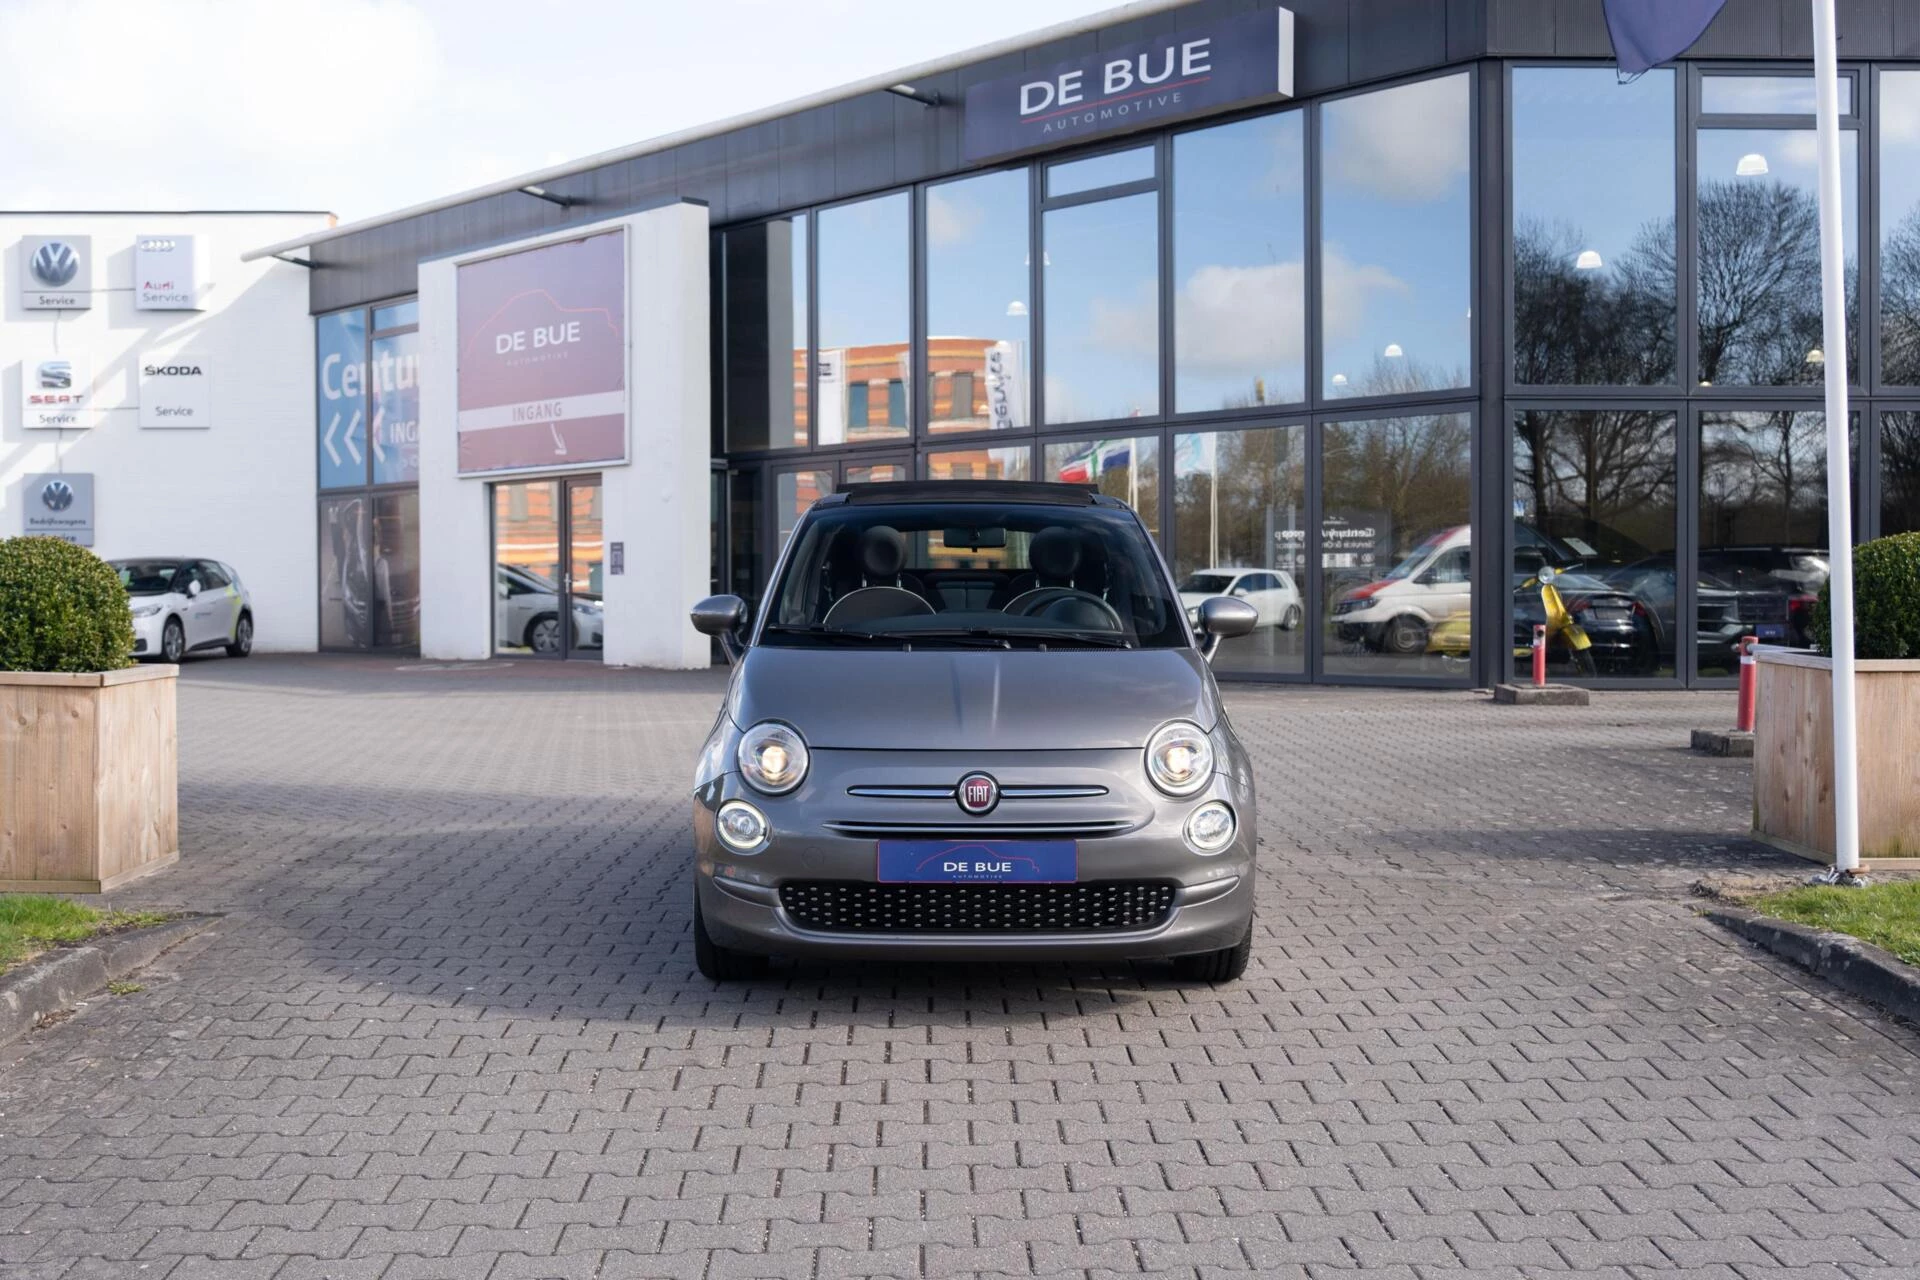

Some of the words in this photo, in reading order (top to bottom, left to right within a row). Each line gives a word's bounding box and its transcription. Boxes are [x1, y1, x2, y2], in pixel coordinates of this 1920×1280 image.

[1019, 70, 1083, 116] DE
[1103, 37, 1212, 95] BUE
[1042, 92, 1182, 134] AUTOMOTIVE
[143, 280, 175, 290] Audi
[39, 295, 76, 305] Service
[142, 292, 189, 302] Service
[496, 330, 526, 354] DE
[533, 321, 581, 348] BUE
[29, 395, 83, 404] SEAT
[155, 406, 193, 417] Service
[512, 401, 562, 422] INGANG
[39, 413, 76, 425] Service
[967, 785, 989, 803] FIAT
[943, 862, 969, 872] DE
[975, 862, 1012, 872] BUE
